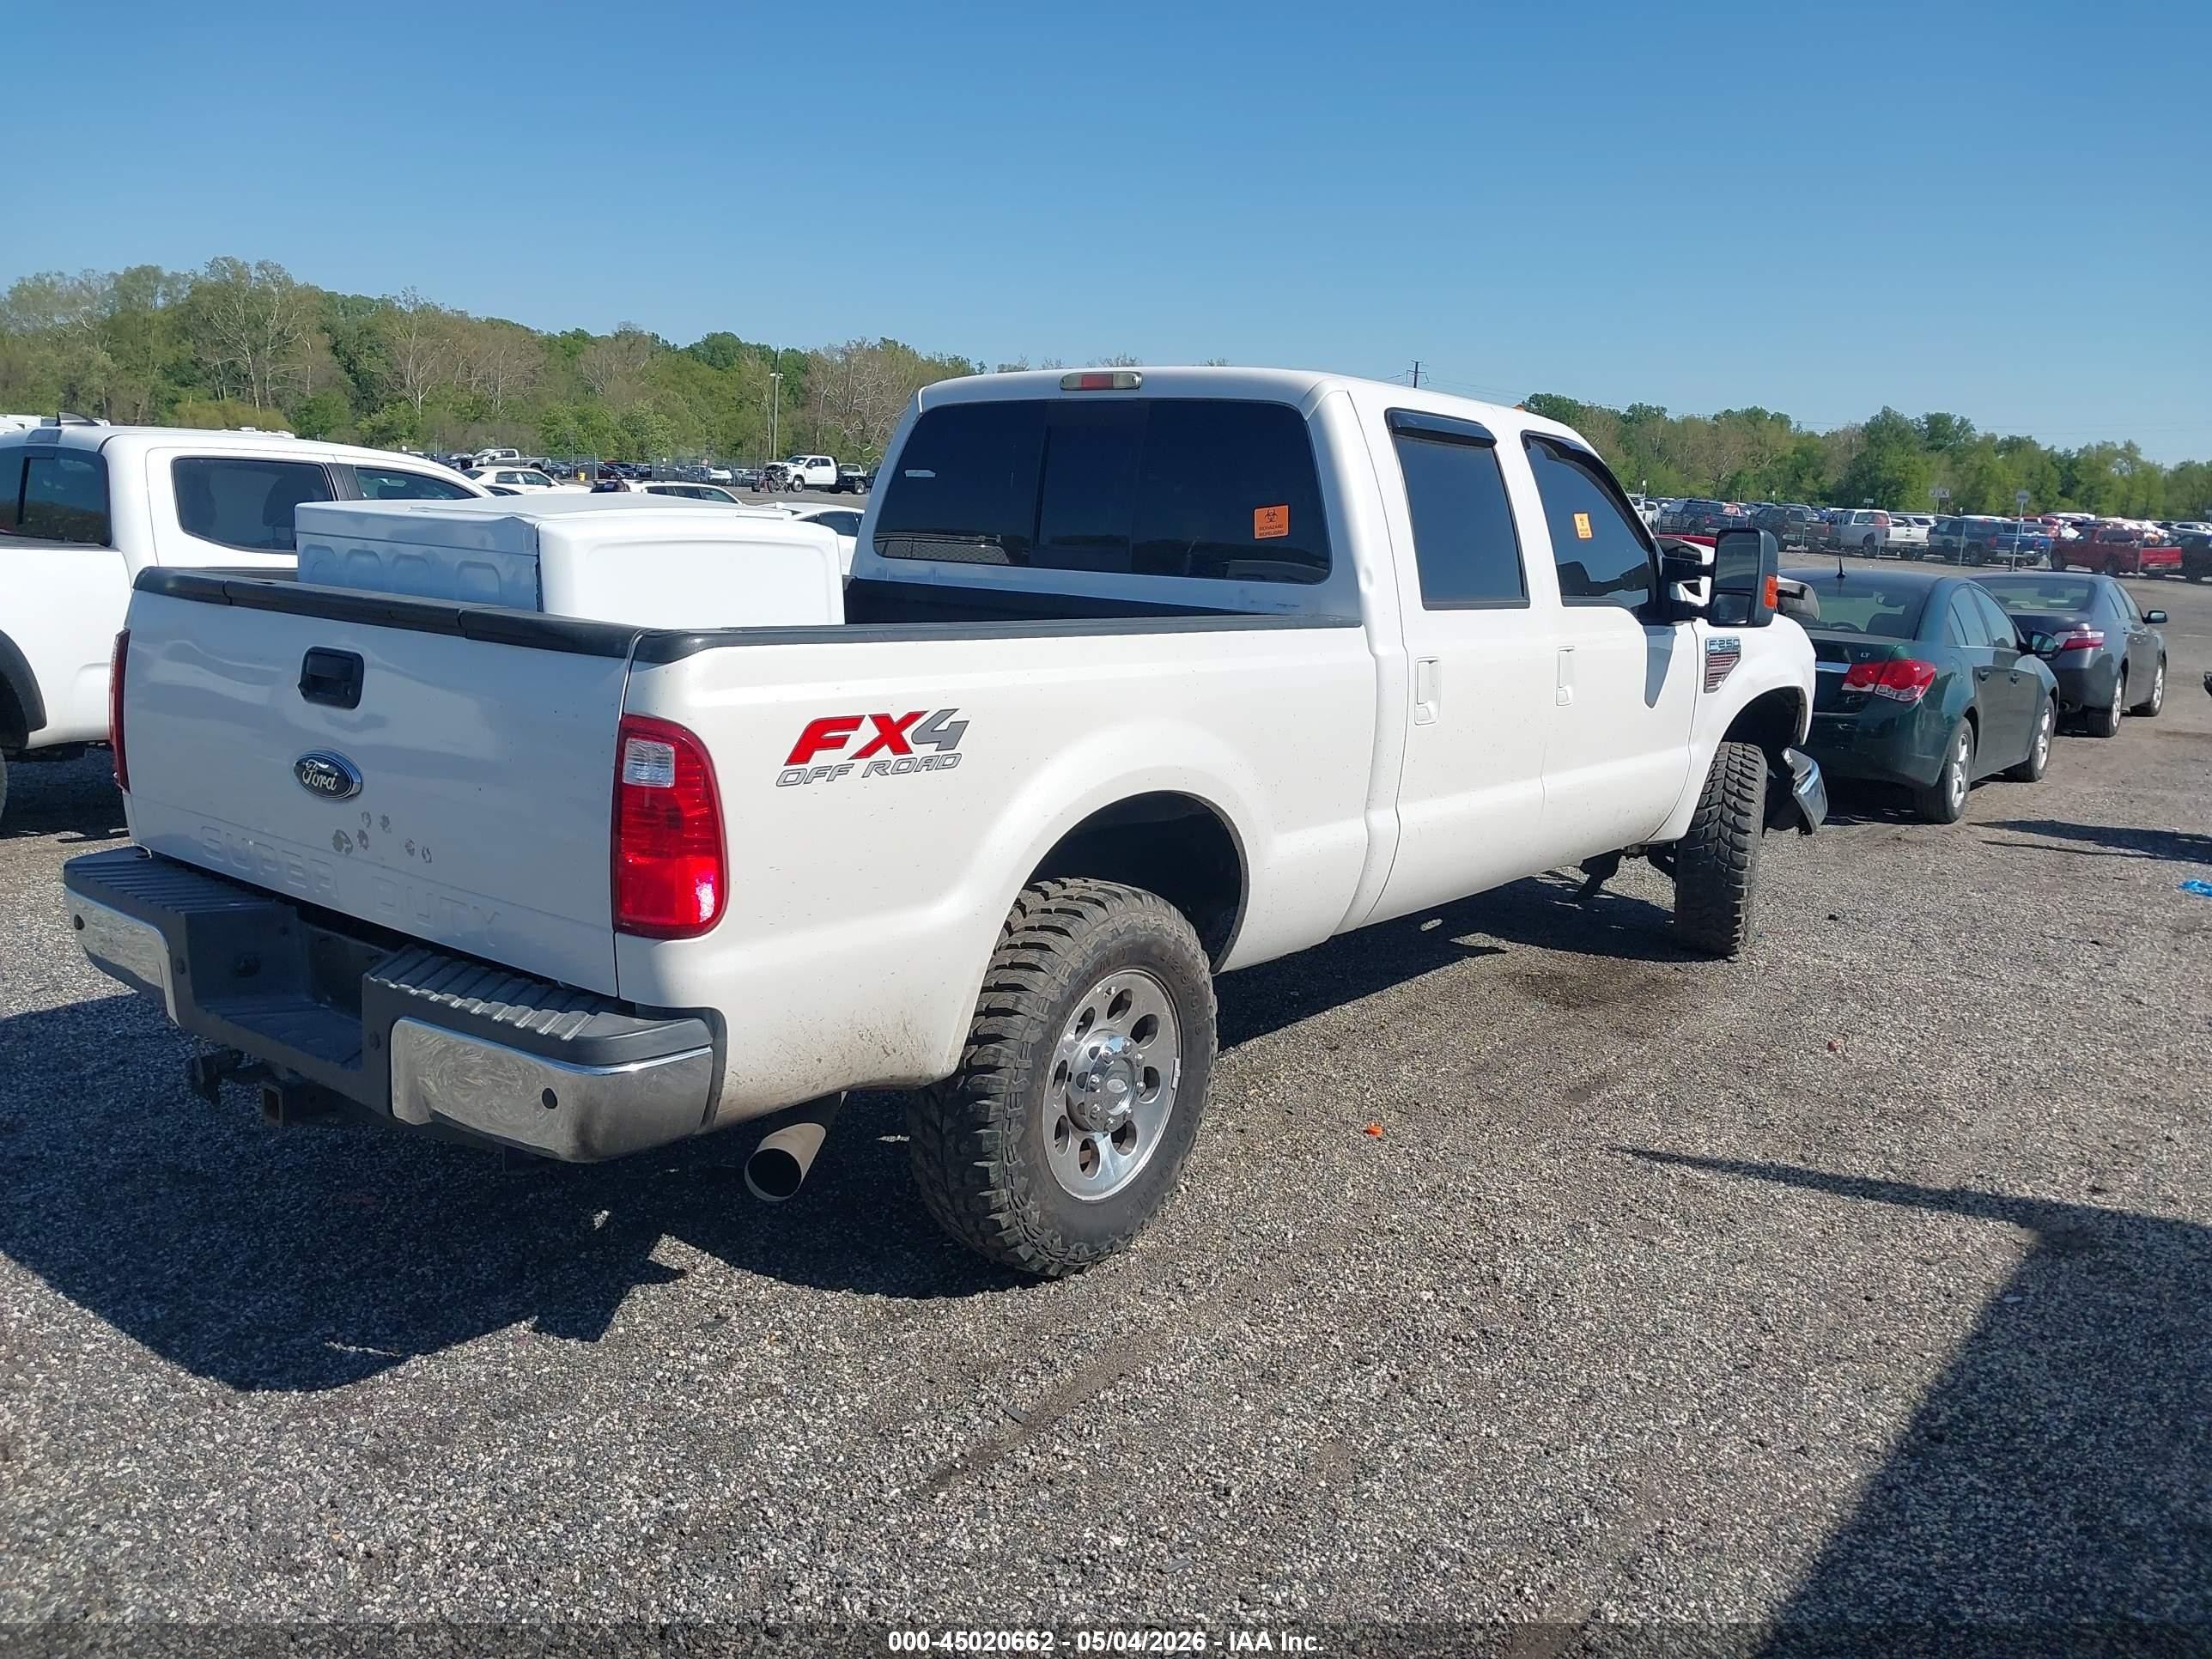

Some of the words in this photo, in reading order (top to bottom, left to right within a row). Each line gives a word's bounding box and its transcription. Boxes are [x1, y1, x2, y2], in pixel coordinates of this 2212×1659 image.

[784, 708, 969, 766] FX4
[302, 759, 337, 791] Ford
[775, 763, 855, 787] OFF
[860, 753, 963, 778] ROAD
